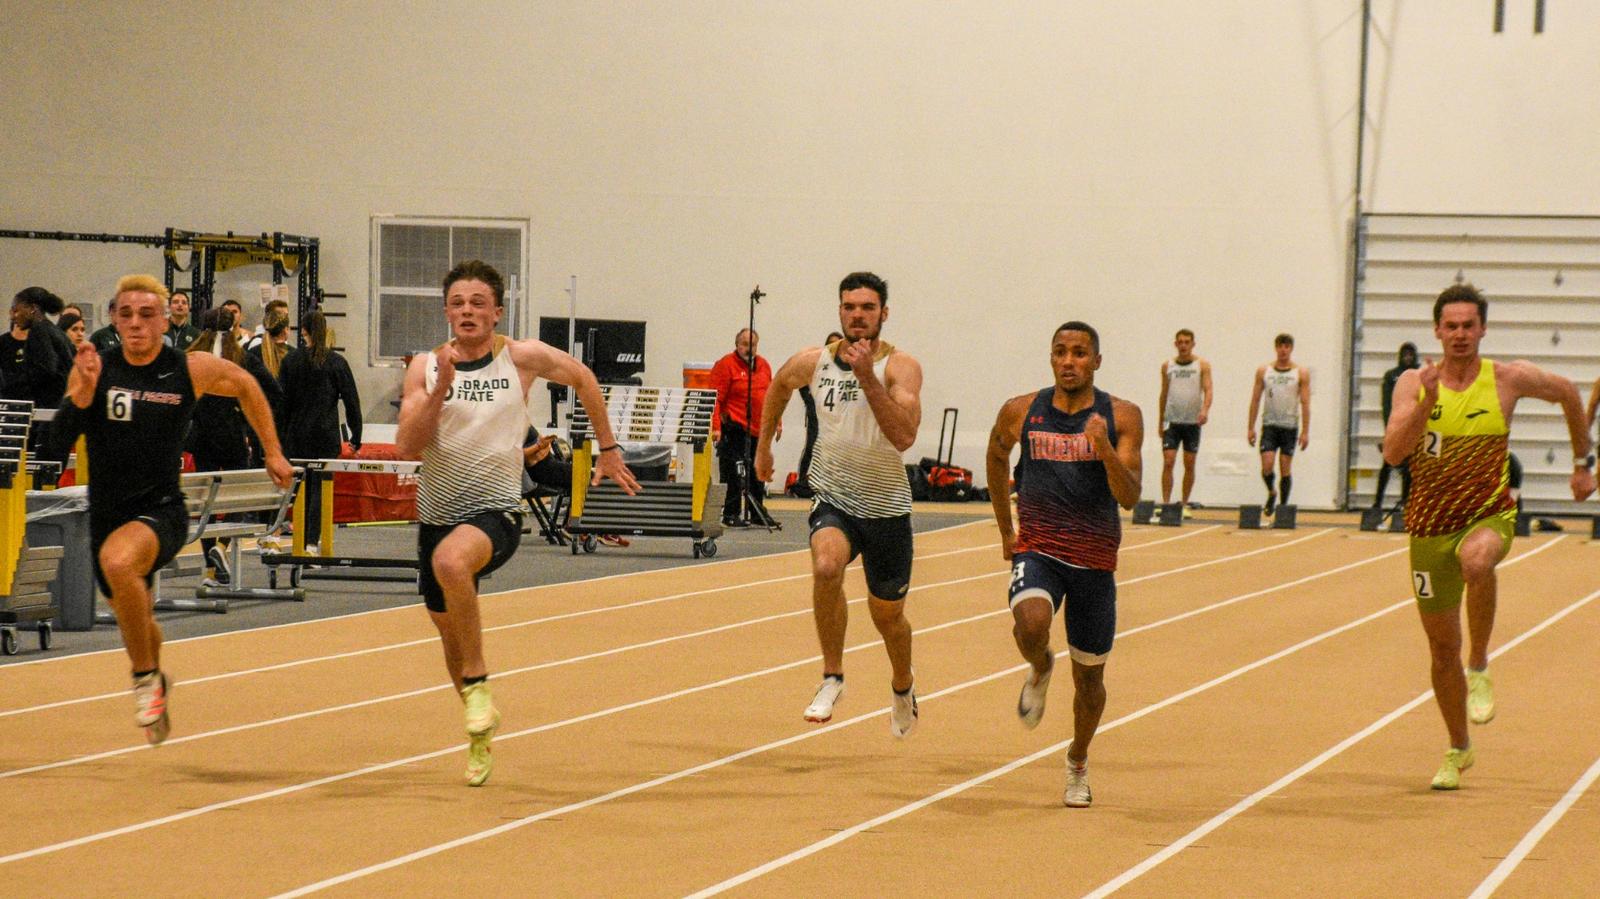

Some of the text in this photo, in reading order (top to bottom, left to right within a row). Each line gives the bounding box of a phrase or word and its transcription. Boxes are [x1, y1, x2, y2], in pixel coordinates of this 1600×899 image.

[617, 353, 642, 362] GILL
[113, 392, 126, 419] 6
[824, 388, 835, 412] 4
[1427, 431, 1437, 455] 2
[1416, 573, 1429, 597] 2
